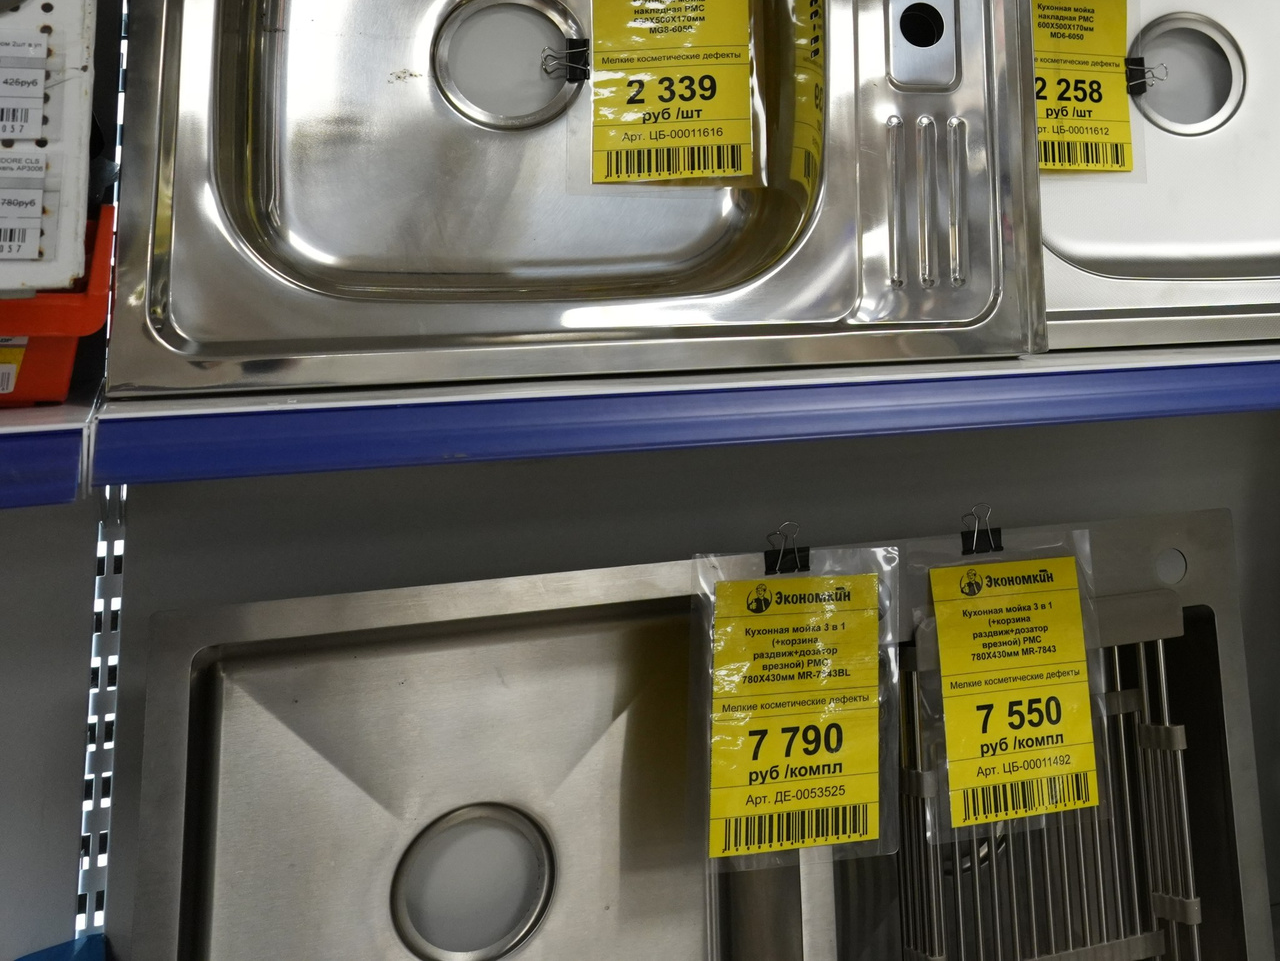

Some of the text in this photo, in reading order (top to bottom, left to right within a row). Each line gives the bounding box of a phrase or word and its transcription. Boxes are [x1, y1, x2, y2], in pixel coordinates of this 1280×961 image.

[1037, 2, 1071, 11] Кухонная
[1037, 13, 1093, 22] накладная РМС
[1049, 31, 1084, 40] MD6-6050
[625, 74, 716, 104] 2 339
[1034, 76, 1102, 103] 2 258
[641, 106, 702, 124] руб /шт
[1045, 105, 1092, 119] руб /шт
[621, 126, 723, 142] Арт. ЦБ-00011616
[1051, 124, 1109, 135] ЦБ-00011612
[961, 607, 1003, 619] Кухонная
[1005, 604, 1031, 612] мойка
[1033, 602, 1038, 610] 3
[1047, 601, 1052, 609] 1
[987, 615, 1031, 627] (+корзина
[981, 635, 1041, 649] врезной) РМС
[1021, 644, 1056, 655] MR-7843
[975, 695, 1061, 733] 7 550
[748, 722, 842, 760] 7 790
[980, 733, 1063, 757] руб /компл
[748, 762, 842, 786] руб /компл
[976, 753, 1070, 778] Арт. ЦБ-00011492
[745, 784, 845, 807] Арт. ДЕ-0053525
